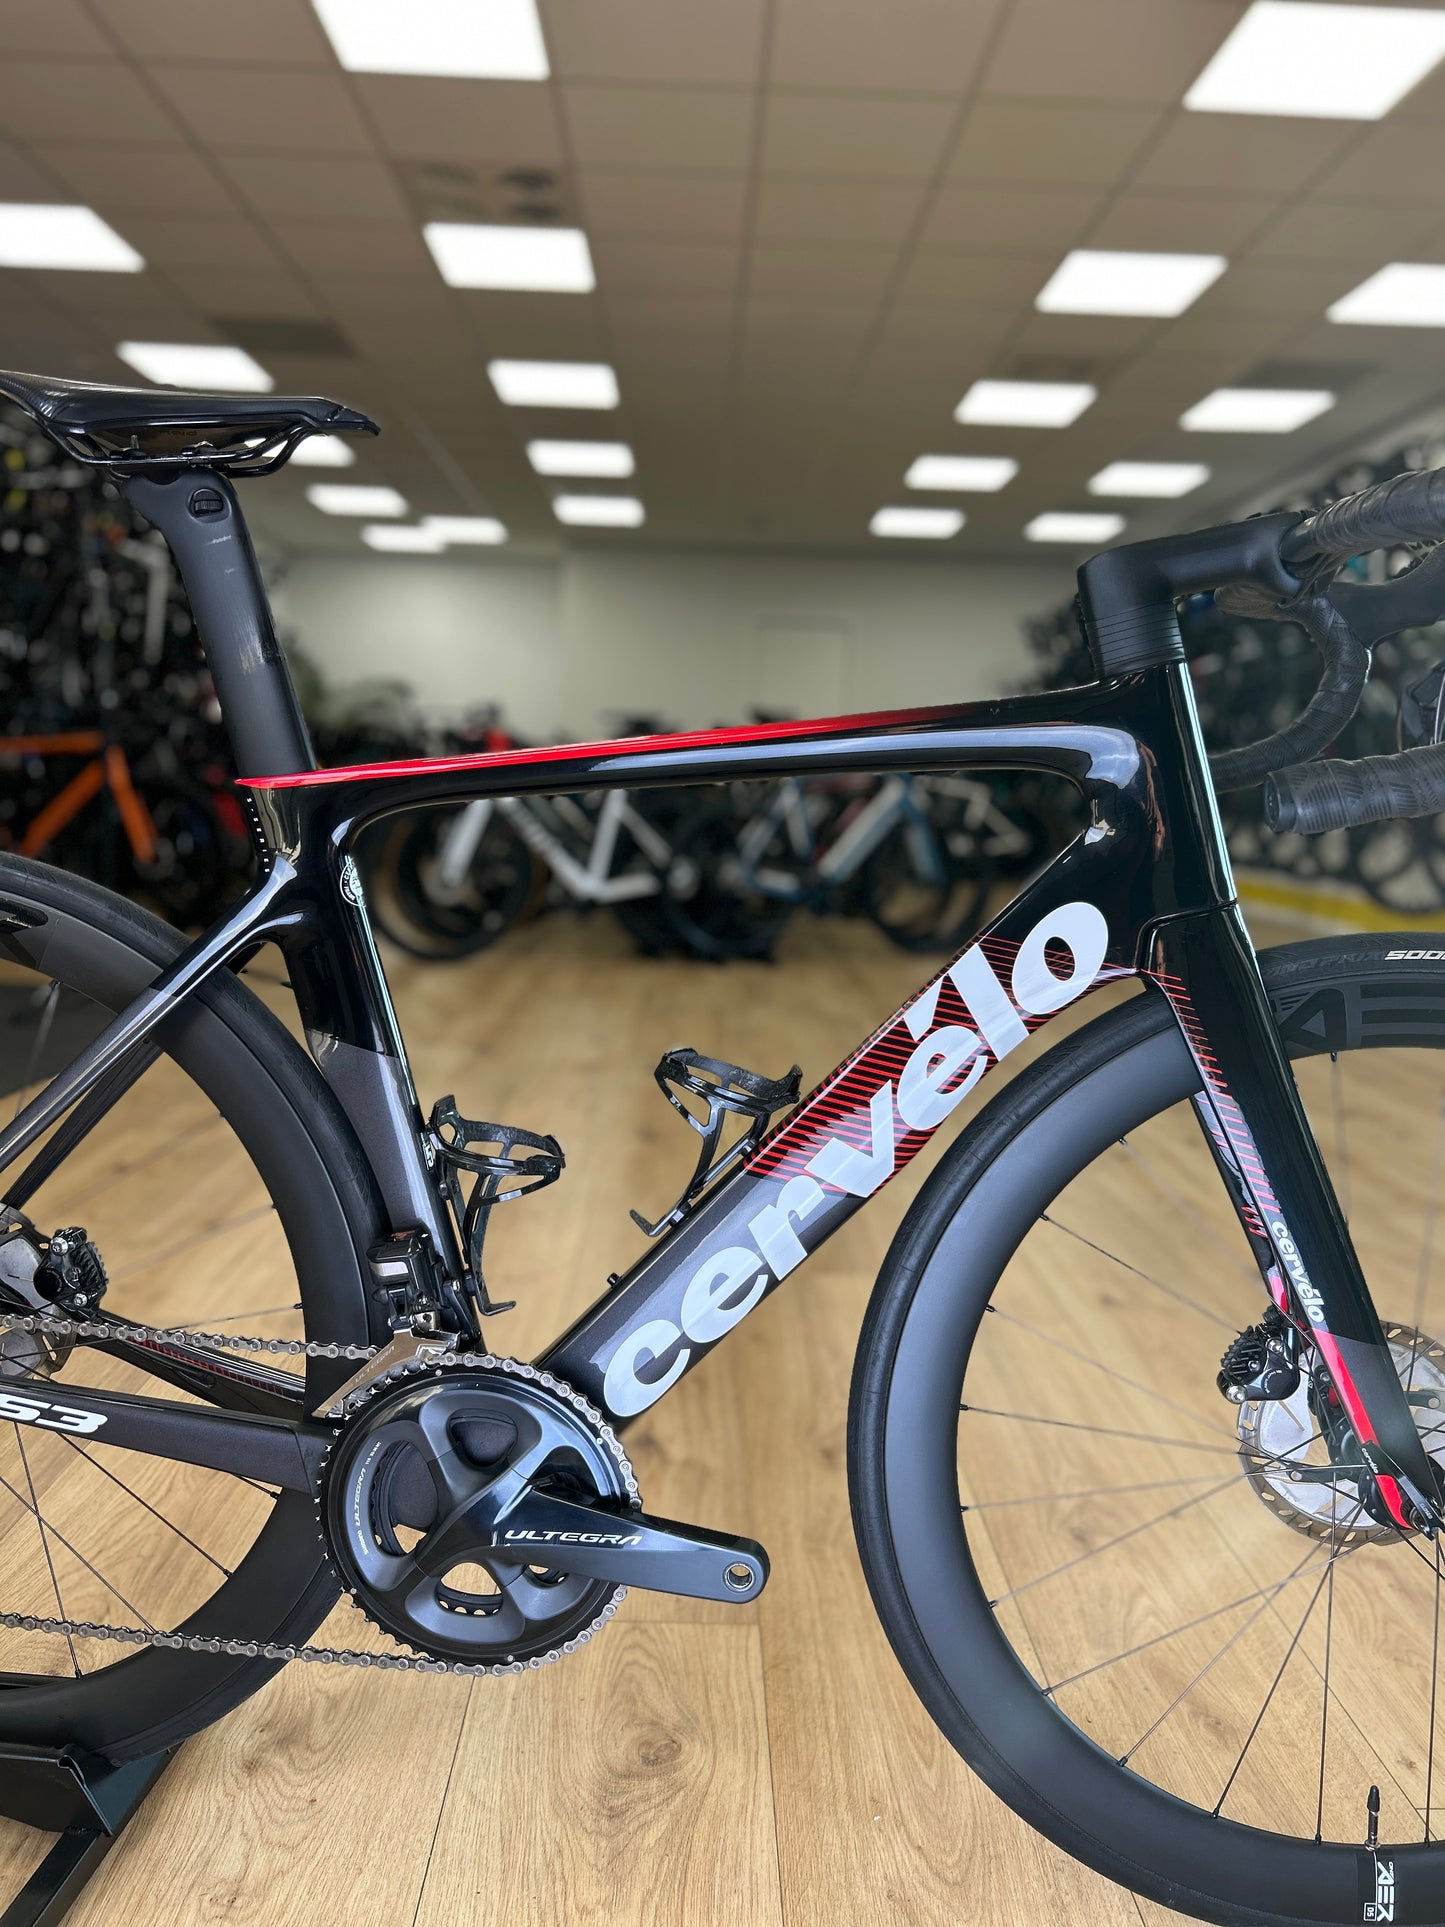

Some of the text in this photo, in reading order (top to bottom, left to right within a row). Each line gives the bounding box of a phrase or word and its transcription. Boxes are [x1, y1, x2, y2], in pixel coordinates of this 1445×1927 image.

[603, 901, 1109, 1418] cervélo
[1271, 1221, 1325, 1323] cervélo
[0, 1393, 108, 1433] S3
[354, 1466, 367, 1527] ULTEGRA
[504, 1529, 643, 1546] ULTEGRA
